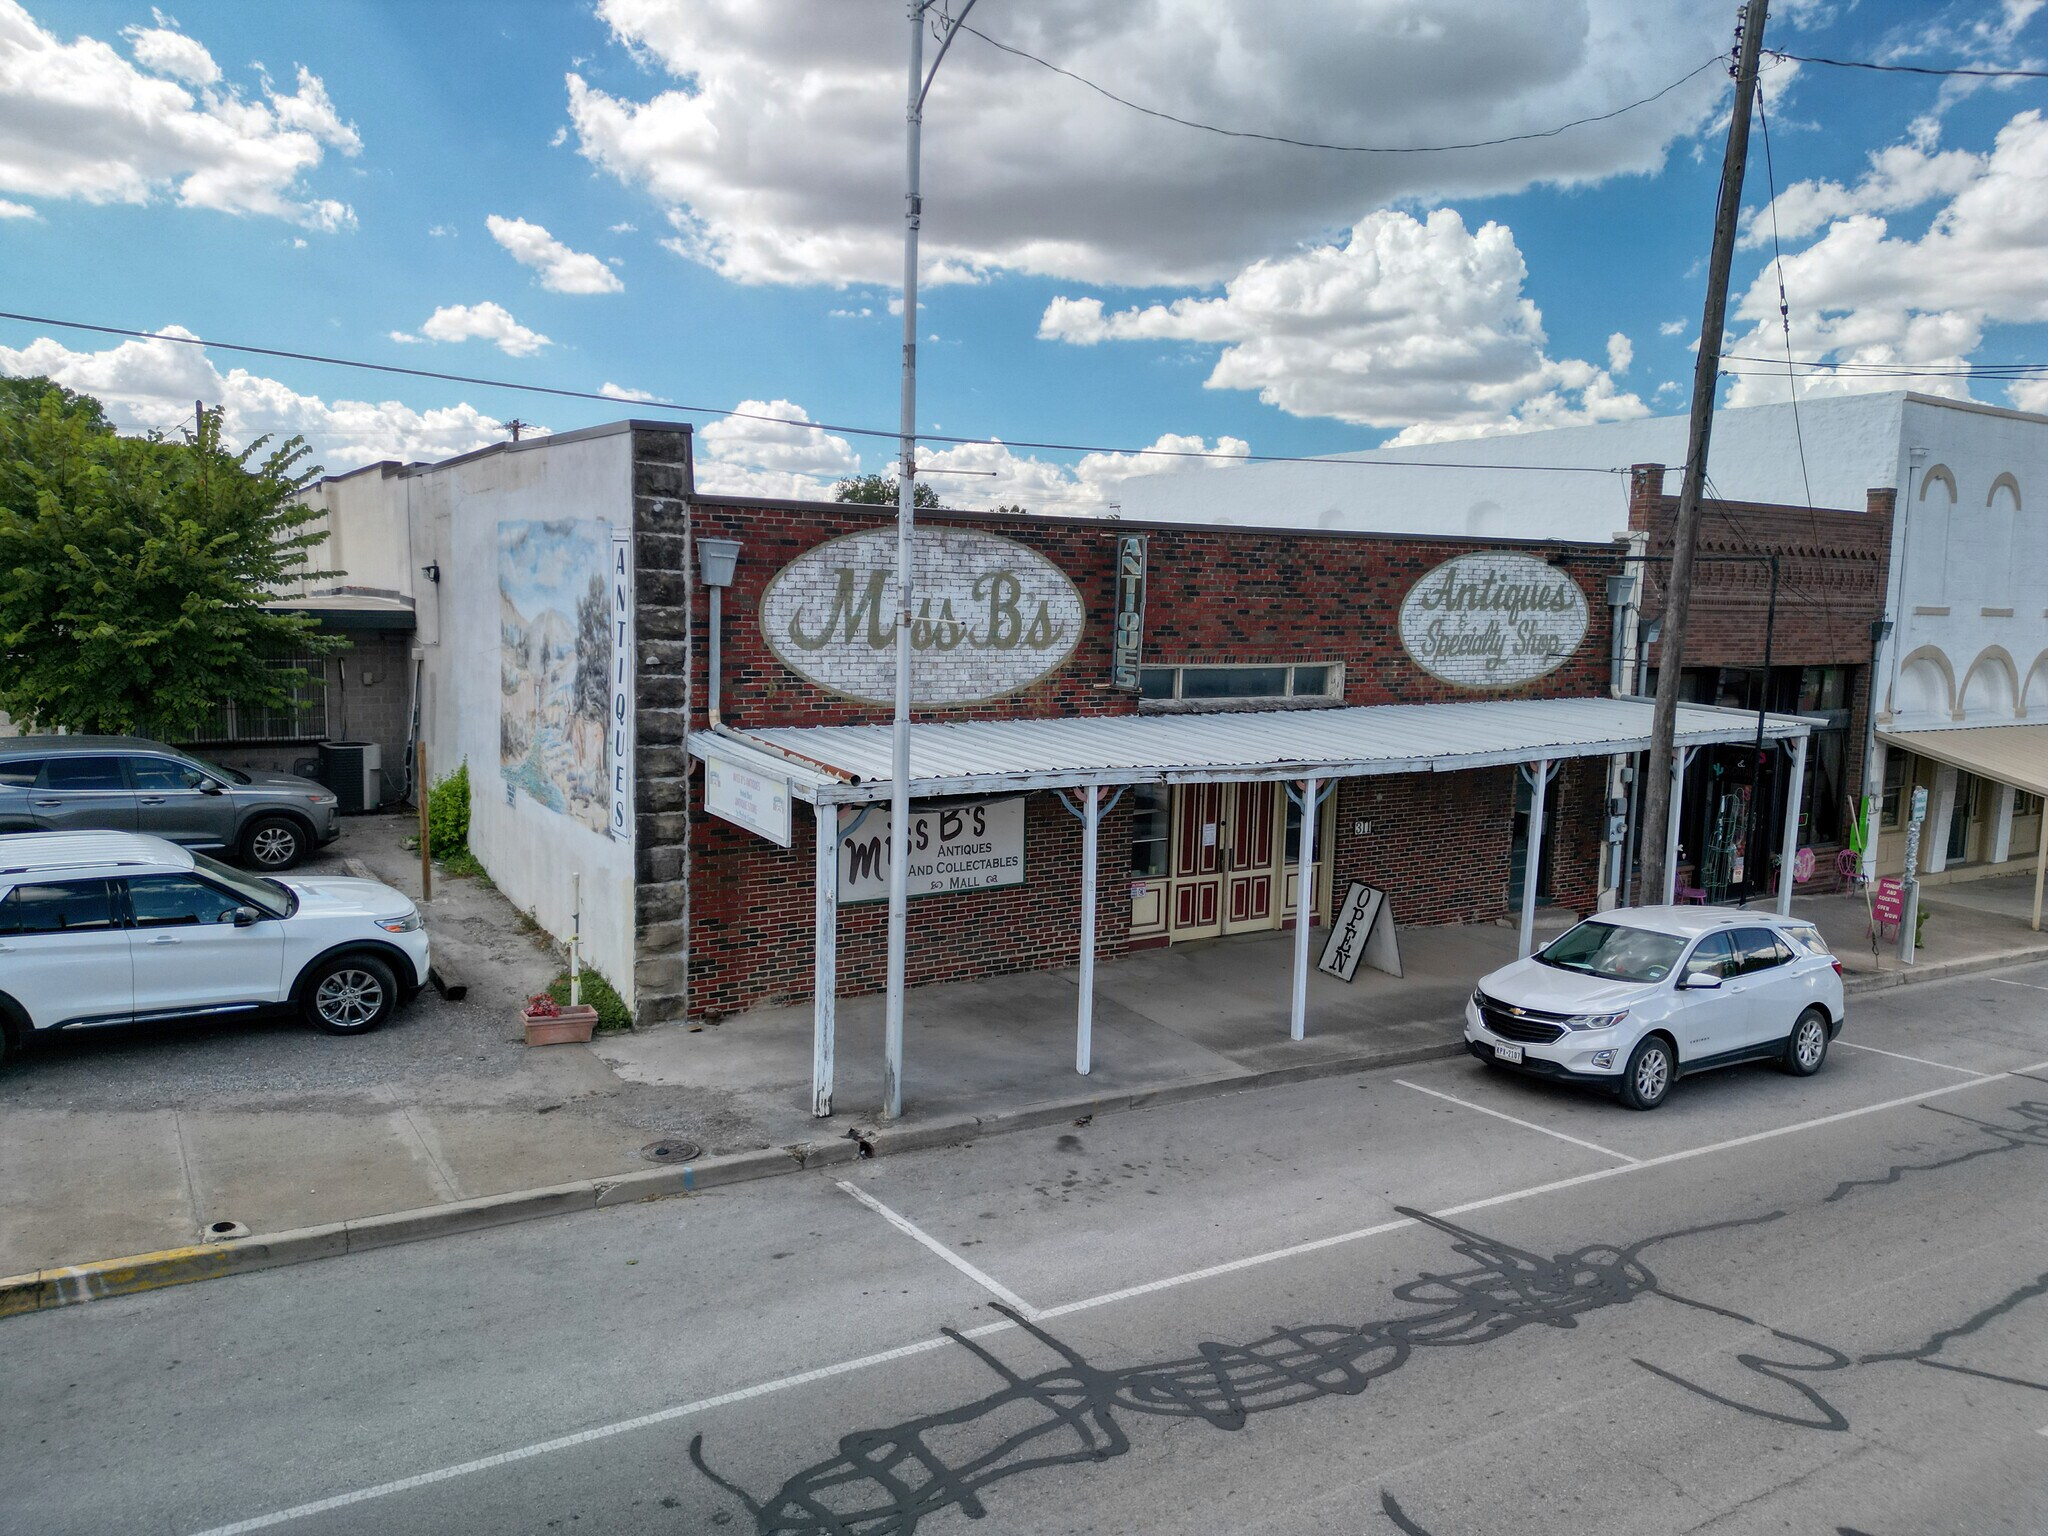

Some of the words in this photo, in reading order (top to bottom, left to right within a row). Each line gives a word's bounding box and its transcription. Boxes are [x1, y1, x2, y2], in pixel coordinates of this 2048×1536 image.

[788, 567, 967, 651] Mss
[966, 569, 1063, 651] B's
[1116, 538, 1142, 688] ANTIQUES
[1421, 566, 1575, 626] Antiques
[1421, 619, 1509, 671] Specialty
[1512, 619, 1565, 666] Shop
[615, 547, 626, 828] ANTIQUES
[908, 862, 933, 878] AND
[936, 855, 1018, 876] COLLECTABLES
[937, 841, 992, 859] ANTIQUES
[949, 875, 980, 889] MALL
[1329, 888, 1371, 974] OPEN
